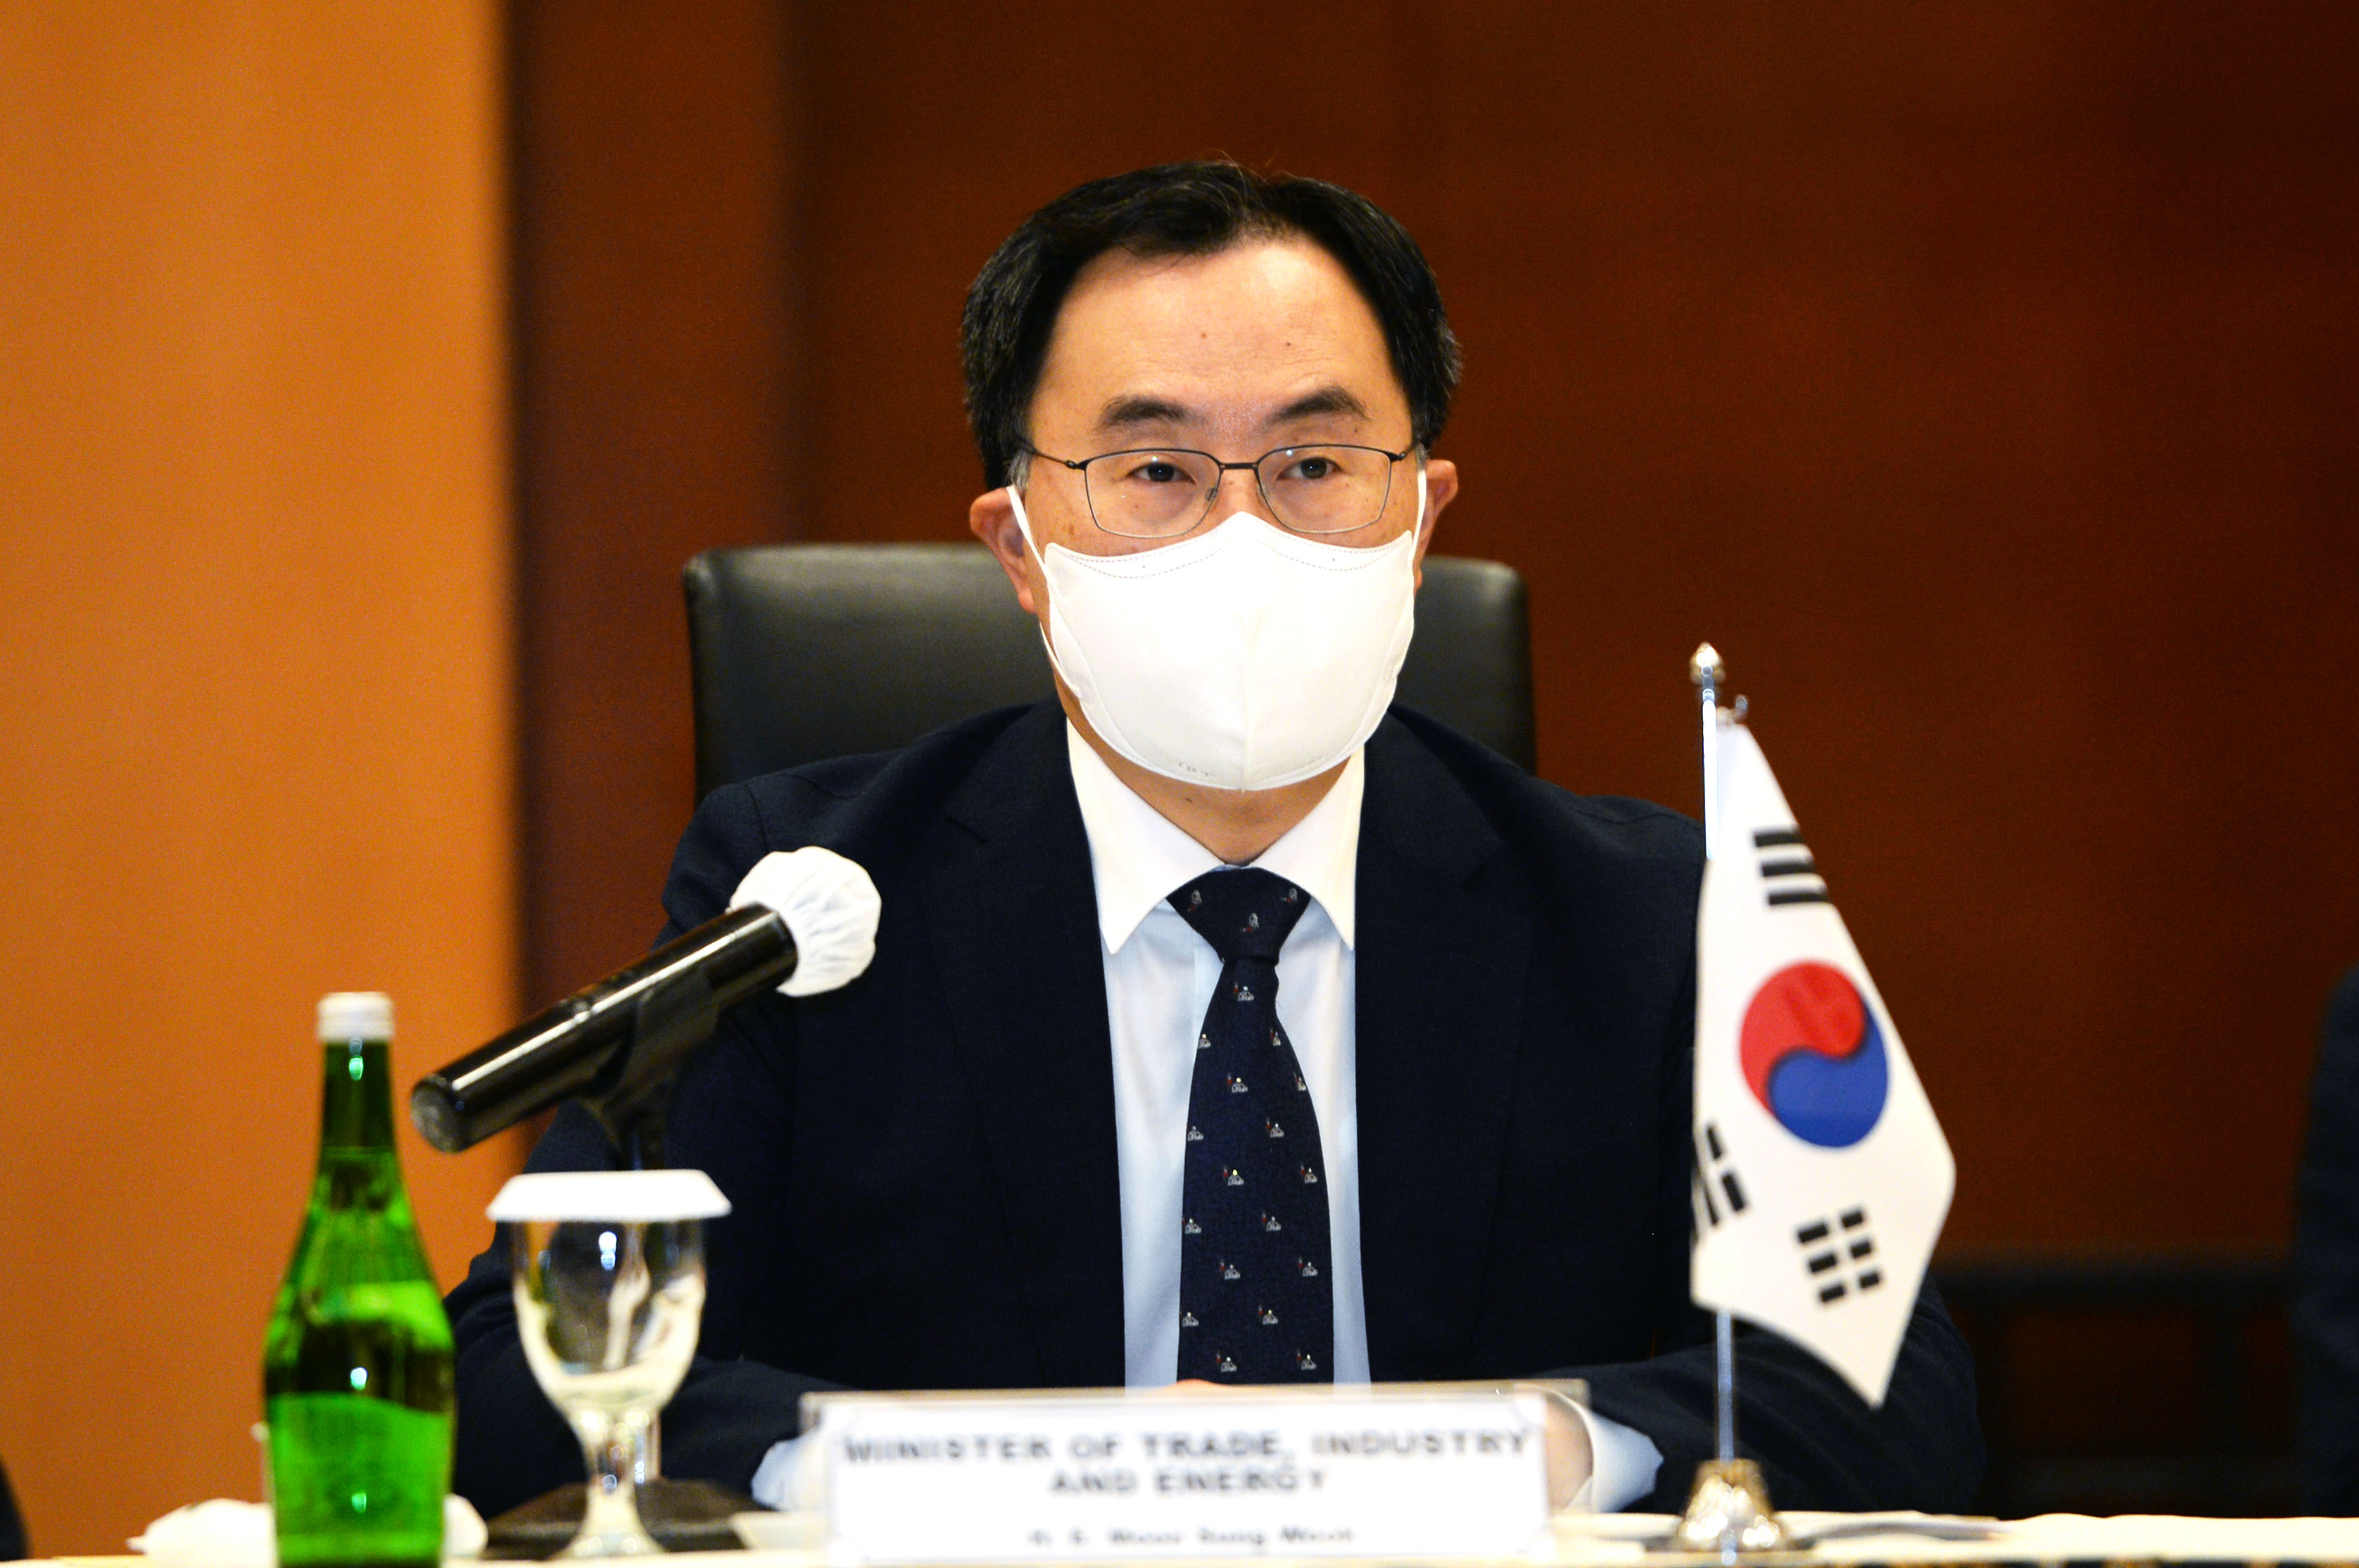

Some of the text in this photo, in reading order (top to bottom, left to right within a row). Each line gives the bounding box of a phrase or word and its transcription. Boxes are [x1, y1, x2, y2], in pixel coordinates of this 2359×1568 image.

[845, 1431, 1527, 1461] MINISTER OF TRADE, INDUSTRY
[1049, 1469, 1327, 1495] AND ENERGY
